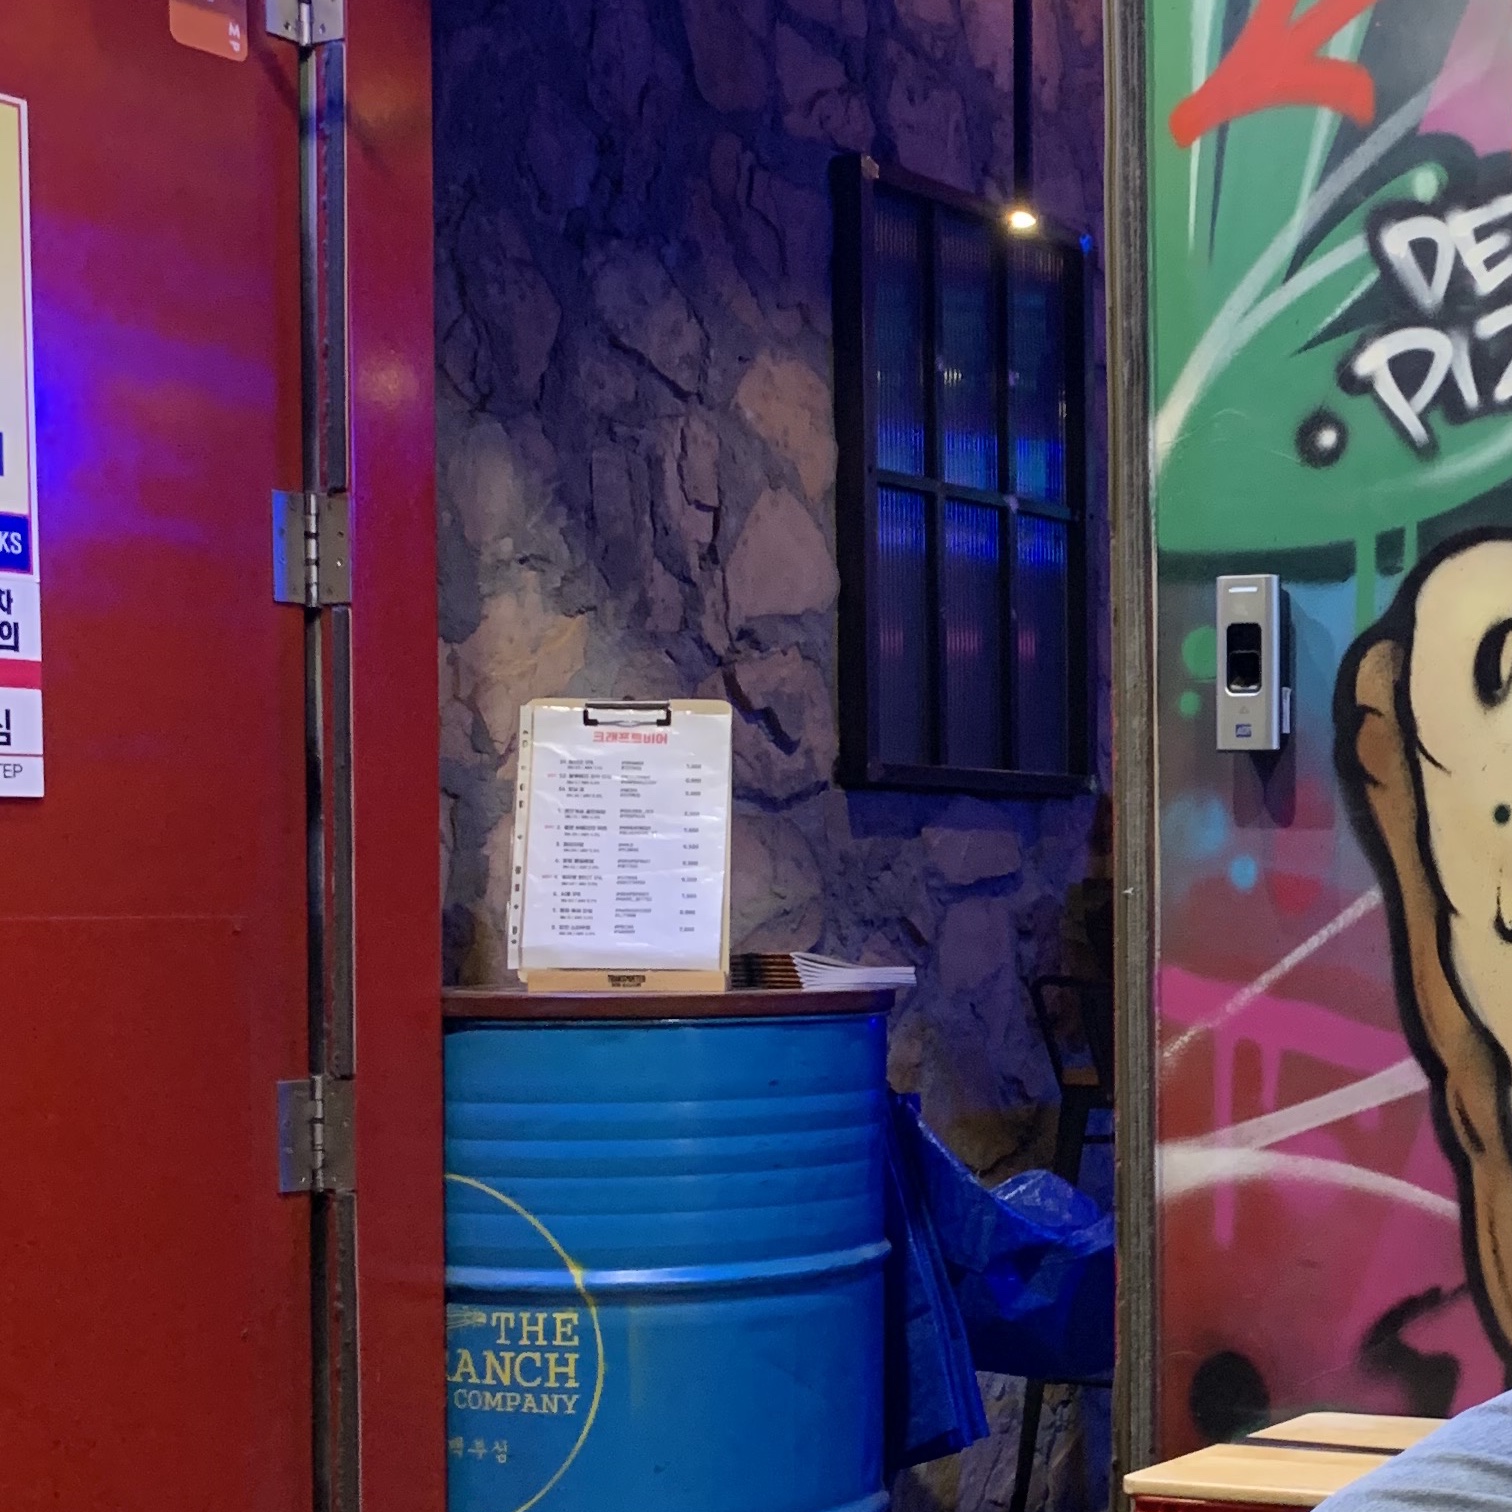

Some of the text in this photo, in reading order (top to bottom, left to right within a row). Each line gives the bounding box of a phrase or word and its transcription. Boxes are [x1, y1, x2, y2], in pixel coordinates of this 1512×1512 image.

[491, 1312, 579, 1346] THE
[447, 1349, 579, 1388] ANCH
[454, 1389, 579, 1414] COMPANY
